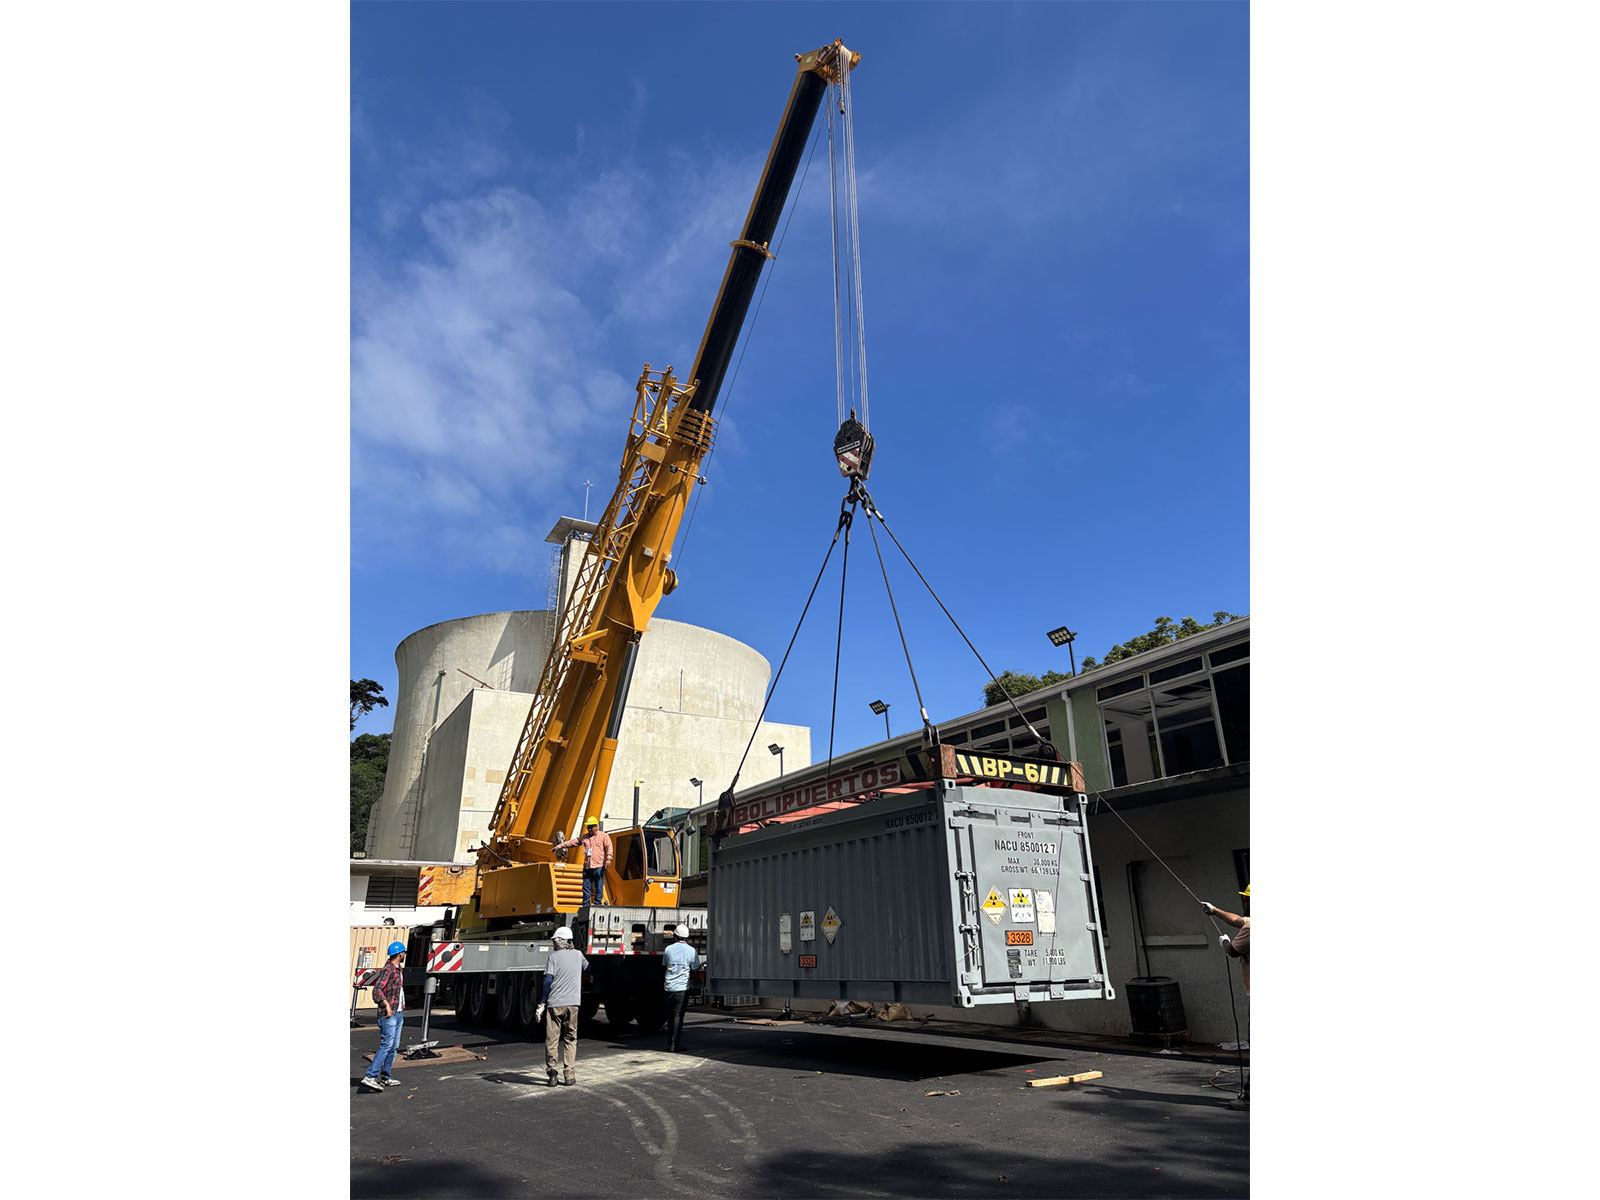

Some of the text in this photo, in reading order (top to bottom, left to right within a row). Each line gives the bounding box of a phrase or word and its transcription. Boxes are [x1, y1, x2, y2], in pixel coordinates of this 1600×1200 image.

[983, 757, 1039, 782] BP-6
[735, 763, 899, 824] BOLIPUERTOS
[885, 816, 904, 829] NACU
[1017, 831, 1034, 839] FRONT
[994, 839, 1018, 852] NACU
[1008, 857, 1020, 865] MAX
[1001, 865, 1019, 873] GROSS
[1010, 933, 1031, 944] 3328
[1024, 949, 1038, 957] TARE
[1058, 948, 1064, 956] KG
[1027, 959, 1036, 967] WT
[1058, 957, 1066, 965] LBS
